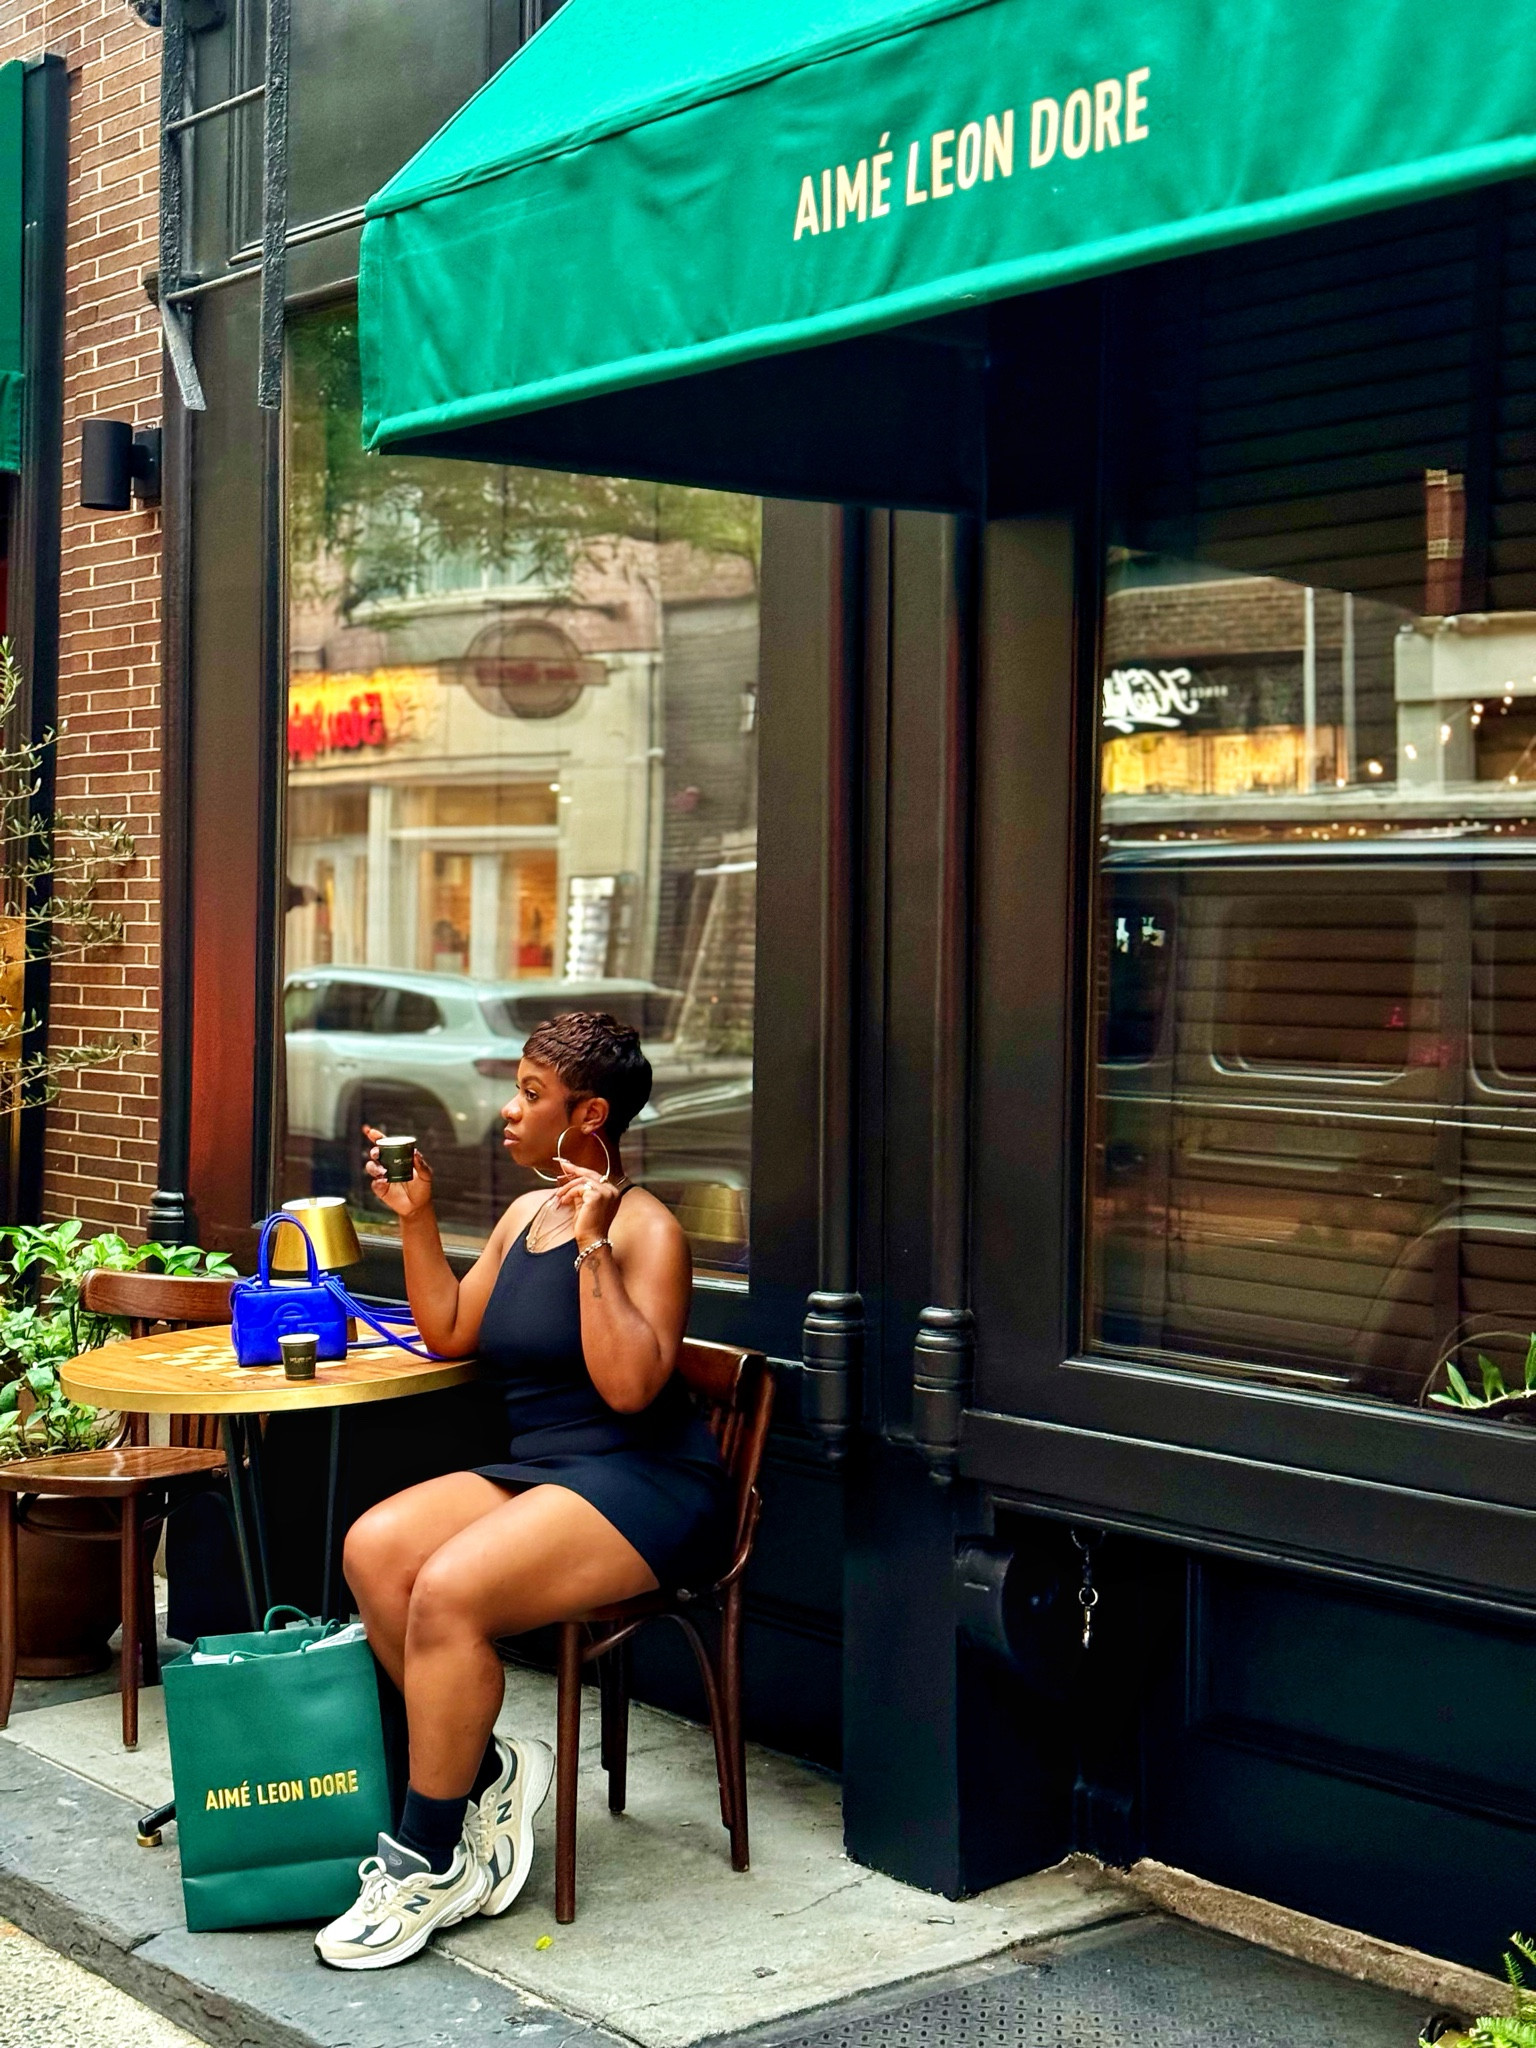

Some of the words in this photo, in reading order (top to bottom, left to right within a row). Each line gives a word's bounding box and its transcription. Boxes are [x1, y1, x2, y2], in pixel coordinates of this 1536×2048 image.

[793, 131, 893, 241] AIMÉ
[906, 108, 1014, 207] LEON
[1030, 66, 1150, 169] DORE
[205, 1780, 251, 1811] AIMÉ
[257, 1779, 304, 1805] LEON
[309, 1769, 359, 1799] DORE
[496, 1798, 512, 1826] N
[402, 1893, 432, 1915] N
